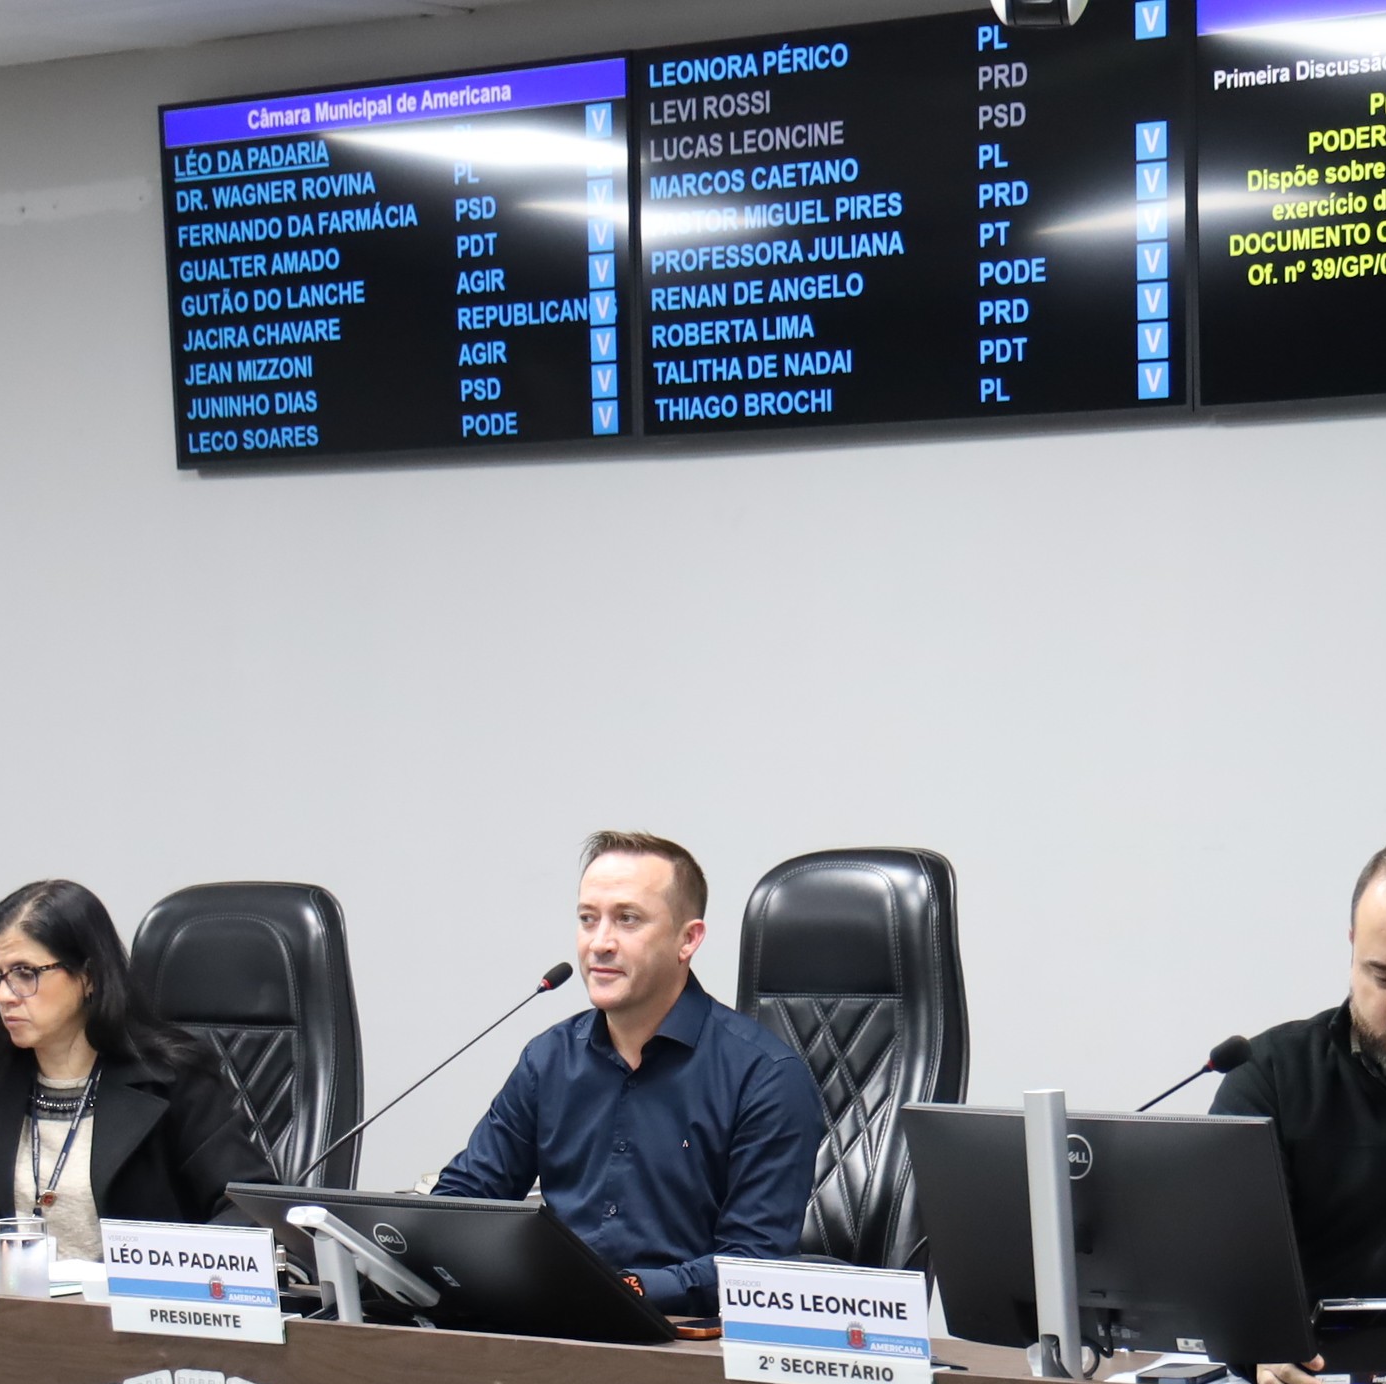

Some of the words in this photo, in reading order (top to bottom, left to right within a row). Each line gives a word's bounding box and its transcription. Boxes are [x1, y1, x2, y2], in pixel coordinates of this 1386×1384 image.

[978, 25, 1007, 52] PL
[649, 58, 757, 89] LEONORA
[763, 41, 848, 75] PÉRICO
[978, 62, 1027, 90] PRD
[1213, 64, 1291, 91] Primeira
[248, 106, 310, 130] Câmara
[314, 95, 392, 124] Municipal
[396, 94, 417, 115] de
[421, 84, 511, 110] Americana
[591, 108, 606, 131] V
[650, 100, 696, 125] LEVI
[703, 90, 770, 119] ROSSI
[978, 102, 1026, 130] PSD
[650, 133, 723, 163] LUCAS
[729, 120, 844, 155] LEONCINE
[1308, 125, 1386, 154] PODER
[174, 146, 212, 178] LÉO
[217, 148, 244, 173] DA
[249, 139, 329, 169] PADARIA
[978, 143, 1007, 170] PL
[455, 161, 479, 185] PL
[650, 168, 744, 200] MARCOS
[751, 158, 858, 189] CAETANO
[1246, 163, 1320, 197] Dispõe
[1325, 159, 1385, 185] sobre
[176, 188, 208, 213] DR.
[213, 177, 295, 208] WAGNER
[302, 171, 376, 200] ROVINA
[978, 180, 1028, 209] PRD
[1271, 189, 1367, 222] exercício
[456, 196, 496, 221] PSD
[651, 202, 738, 237] PASTOR
[744, 198, 829, 230] MIGUEL
[835, 192, 902, 222] PIRES
[178, 215, 284, 248] FERNANDO
[289, 212, 313, 236] DA
[319, 202, 417, 235] FARMÁCIA
[979, 221, 1010, 248] PT
[1229, 219, 1371, 258] DOCUMENTO
[457, 232, 498, 258] PDT
[651, 241, 803, 276] PROFESSORA
[808, 231, 904, 263] JULIANA
[179, 254, 266, 283] GUALTER
[271, 247, 340, 276] AMADO
[979, 257, 1046, 287] PODE
[1247, 260, 1278, 287] Of.
[1283, 259, 1306, 284] nº
[457, 268, 505, 295] AGIR
[651, 283, 728, 312] RENAN
[735, 279, 763, 306] DE
[768, 273, 863, 303] ANGELO
[182, 287, 249, 318] GUTÃO
[254, 285, 282, 312] DO
[287, 280, 365, 309] LANCHE
[979, 299, 1028, 326] PRD
[458, 299, 617, 331] REPUBLICAN
[183, 323, 249, 352] JACIRA
[253, 318, 341, 347] CHAVARE
[651, 319, 757, 348] ROBERTA
[762, 315, 814, 341] LIMA
[458, 341, 506, 367] AGIR
[979, 338, 1027, 365] PDT
[185, 359, 232, 387] JEAN
[237, 355, 314, 383] MIZZONI
[654, 359, 742, 386] TALITHA
[748, 354, 777, 381] DE
[783, 349, 852, 376] NADAI
[1145, 368, 1162, 393] V
[460, 377, 501, 402] PSD
[980, 378, 1010, 404] PL
[187, 395, 270, 421] JUNINHO
[275, 391, 317, 415] DIAS
[655, 394, 738, 422] THIAGO
[744, 389, 832, 418] BROCHI
[462, 412, 518, 437] PODE
[189, 429, 238, 454] LECO
[243, 425, 319, 450] SOARES
[1068, 1151, 1088, 1163] ELL
[378, 1234, 403, 1244] DELL
[110, 1244, 143, 1264] LÉO
[148, 1250, 174, 1267] DA
[178, 1252, 259, 1272] PADARIA
[724, 1279, 761, 1287] VEREADOR
[228, 1294, 272, 1304] AMERICANA
[726, 1288, 794, 1310] LUCAS
[800, 1294, 907, 1320] LEONCINE
[150, 1309, 241, 1328] PRESIDENTE
[870, 1342, 923, 1355] AMERICANA
[758, 1356, 774, 1370] 2º
[781, 1358, 894, 1382] SECRETÁRIO
